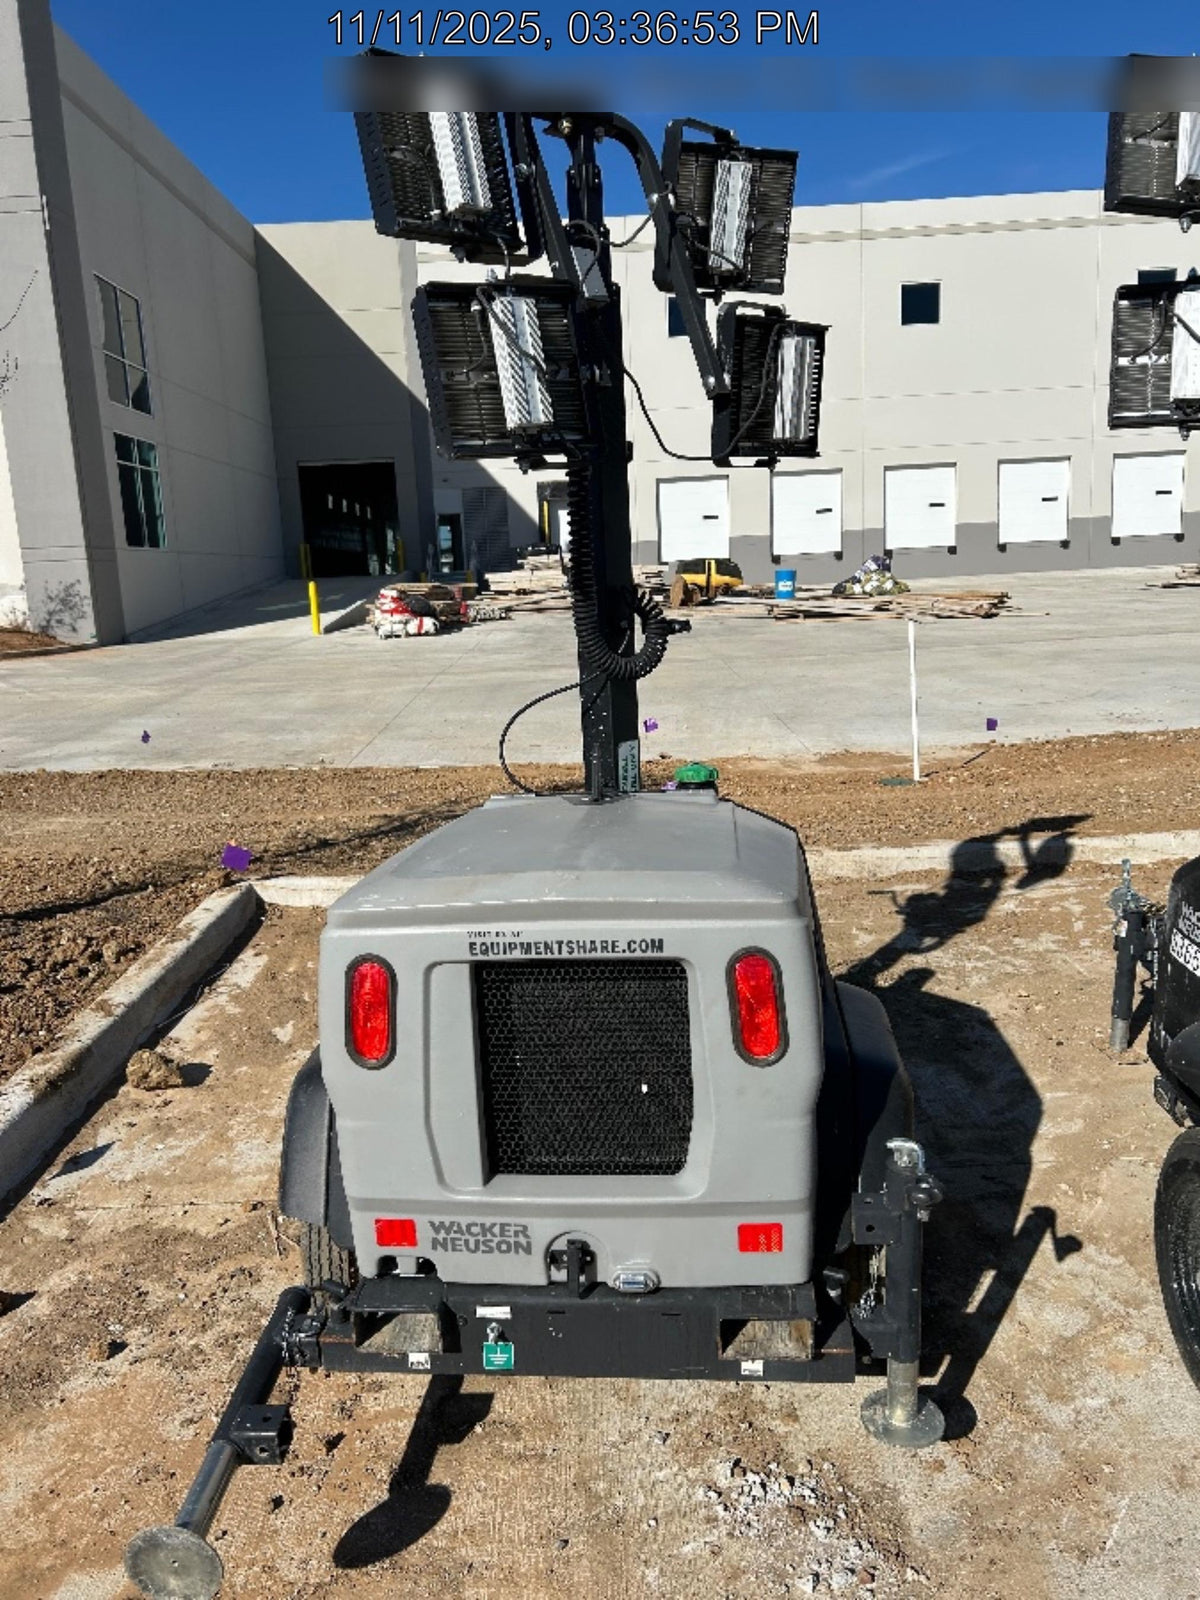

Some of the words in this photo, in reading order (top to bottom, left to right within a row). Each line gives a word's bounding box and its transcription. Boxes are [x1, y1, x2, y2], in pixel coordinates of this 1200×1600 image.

[469, 938, 664, 957] EQUIPMENTSHARE.COM
[428, 1220, 532, 1239] WACKER
[431, 1237, 532, 1255] NEUSON
